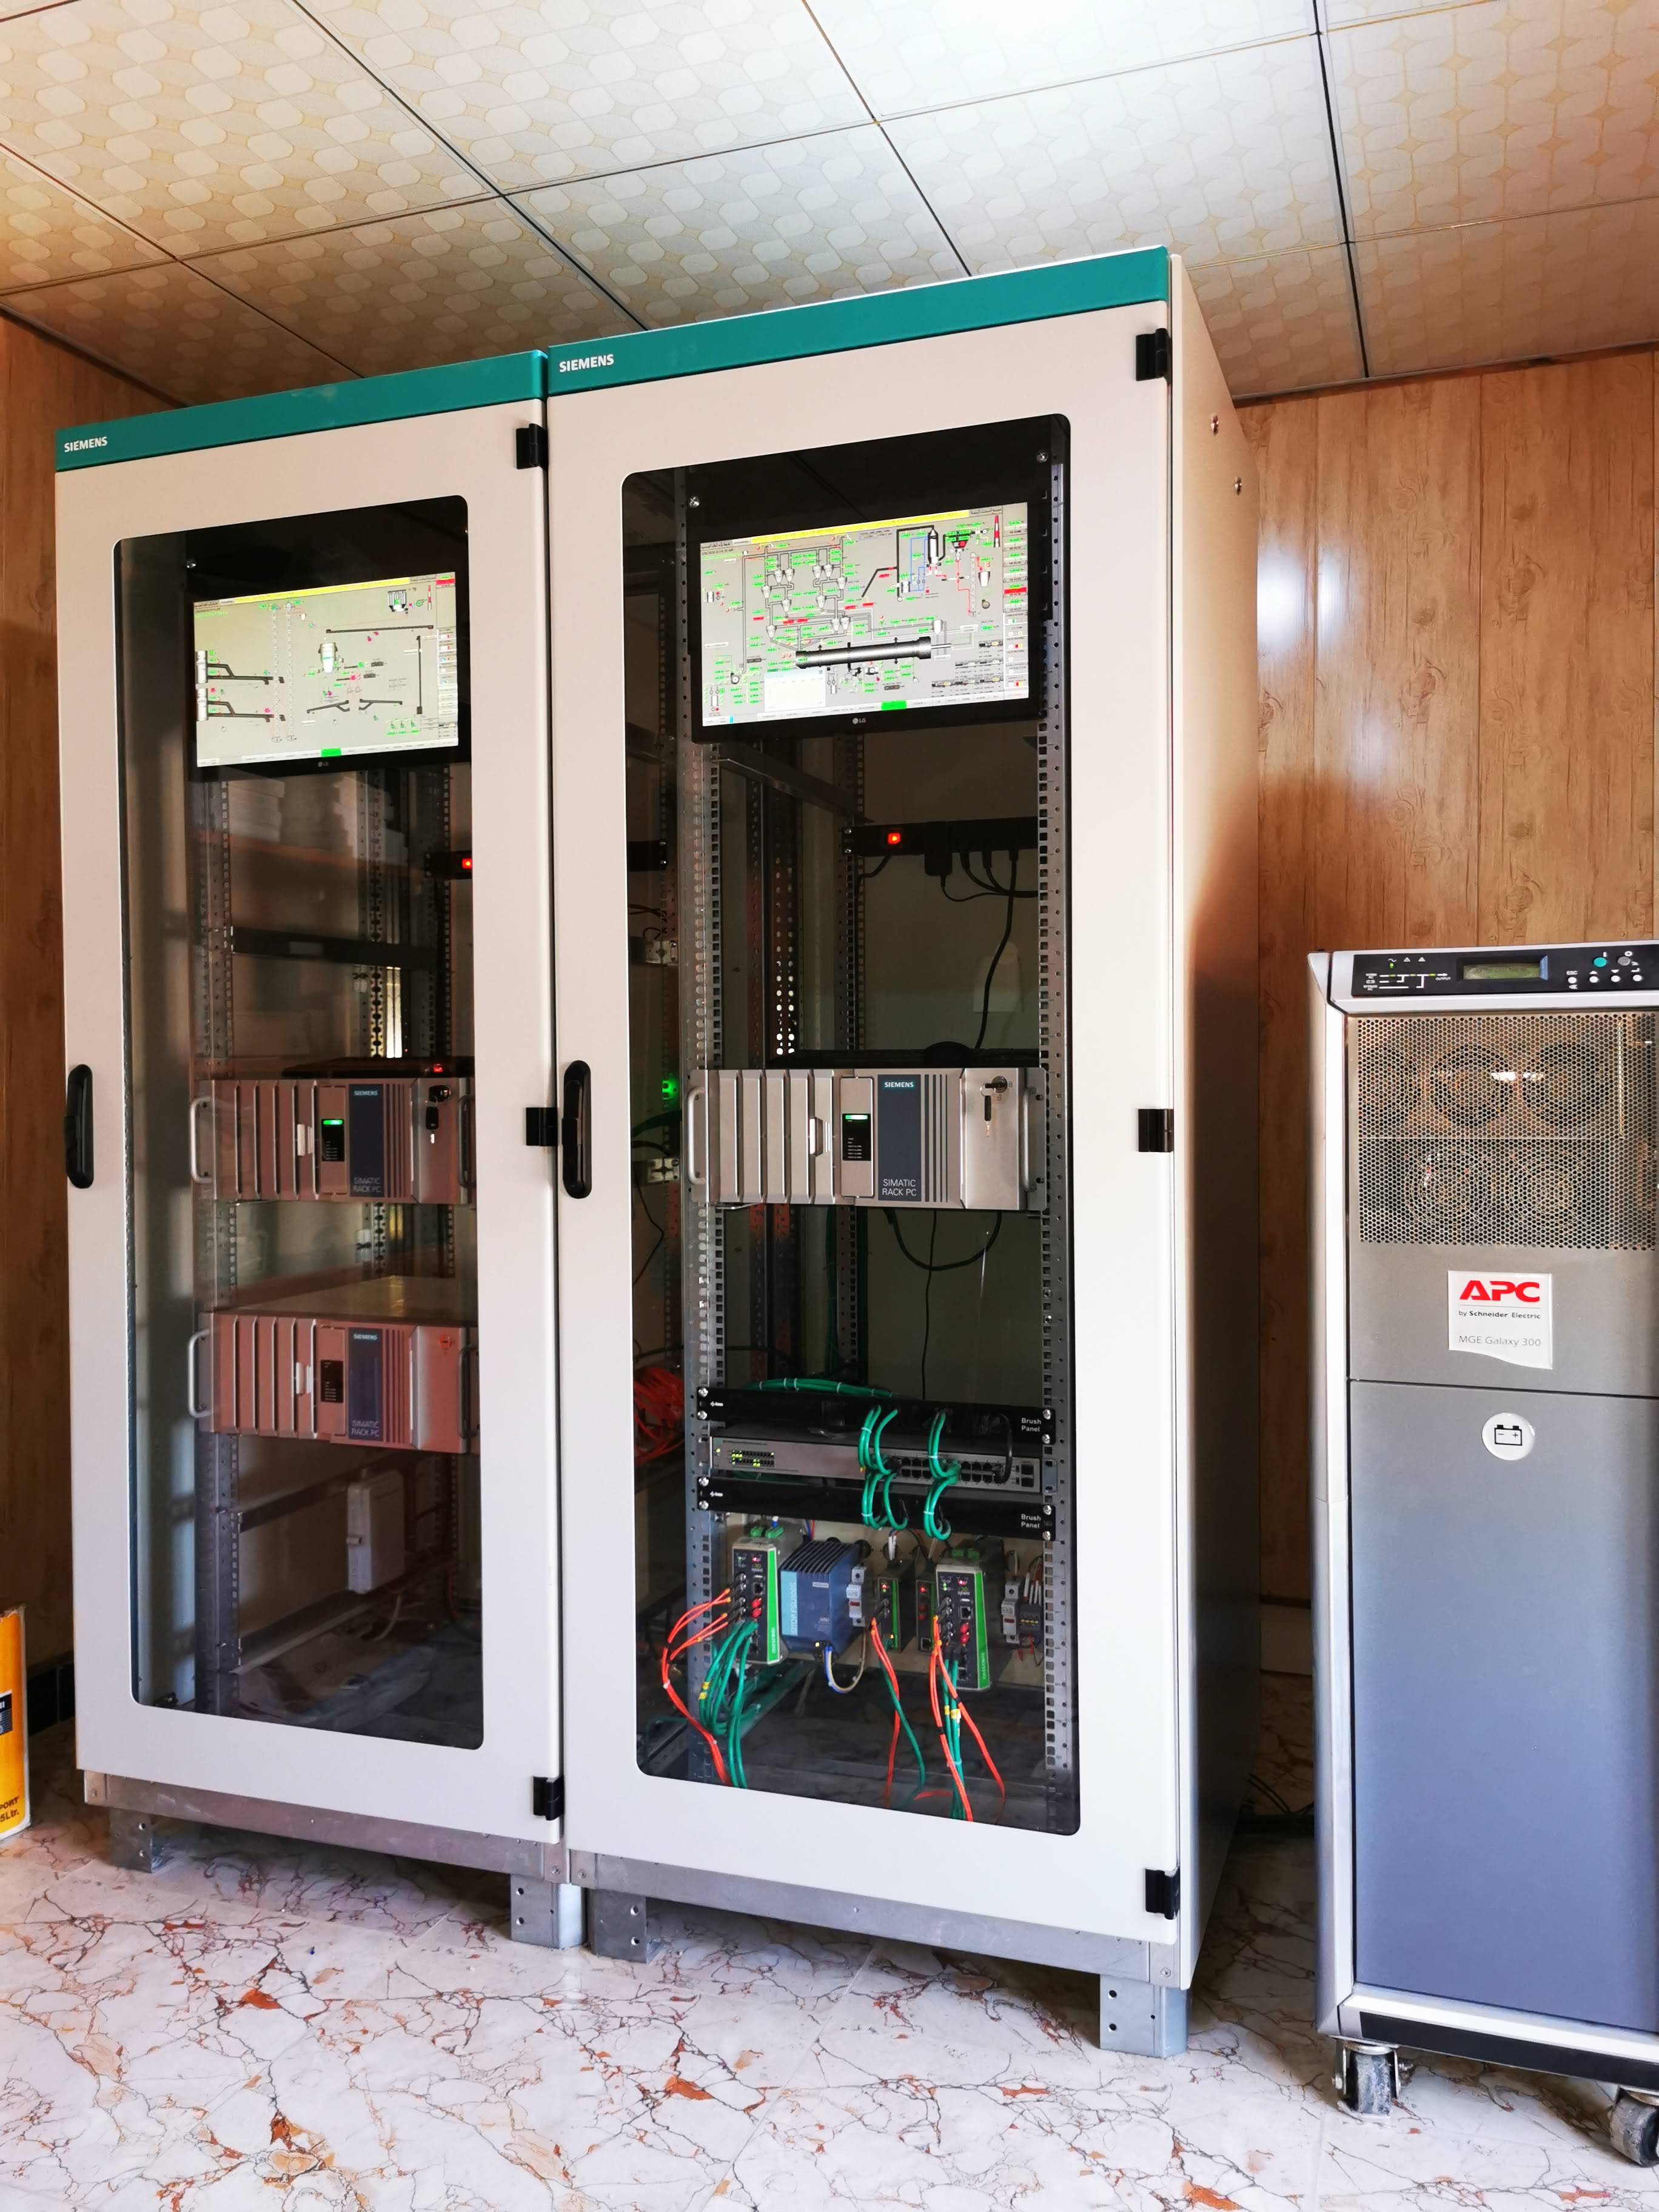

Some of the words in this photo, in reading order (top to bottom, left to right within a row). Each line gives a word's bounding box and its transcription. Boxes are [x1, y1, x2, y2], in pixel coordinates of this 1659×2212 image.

[559, 354, 614, 372] SIEMENS
[64, 437, 108, 452] SIEMENS
[883, 1178, 916, 1187] SIMATIC
[1460, 1280, 1540, 1302] APC
[1459, 1335, 1483, 1344] MGE
[1485, 1336, 1520, 1347] Galaxy
[1522, 1338, 1541, 1347] 300
